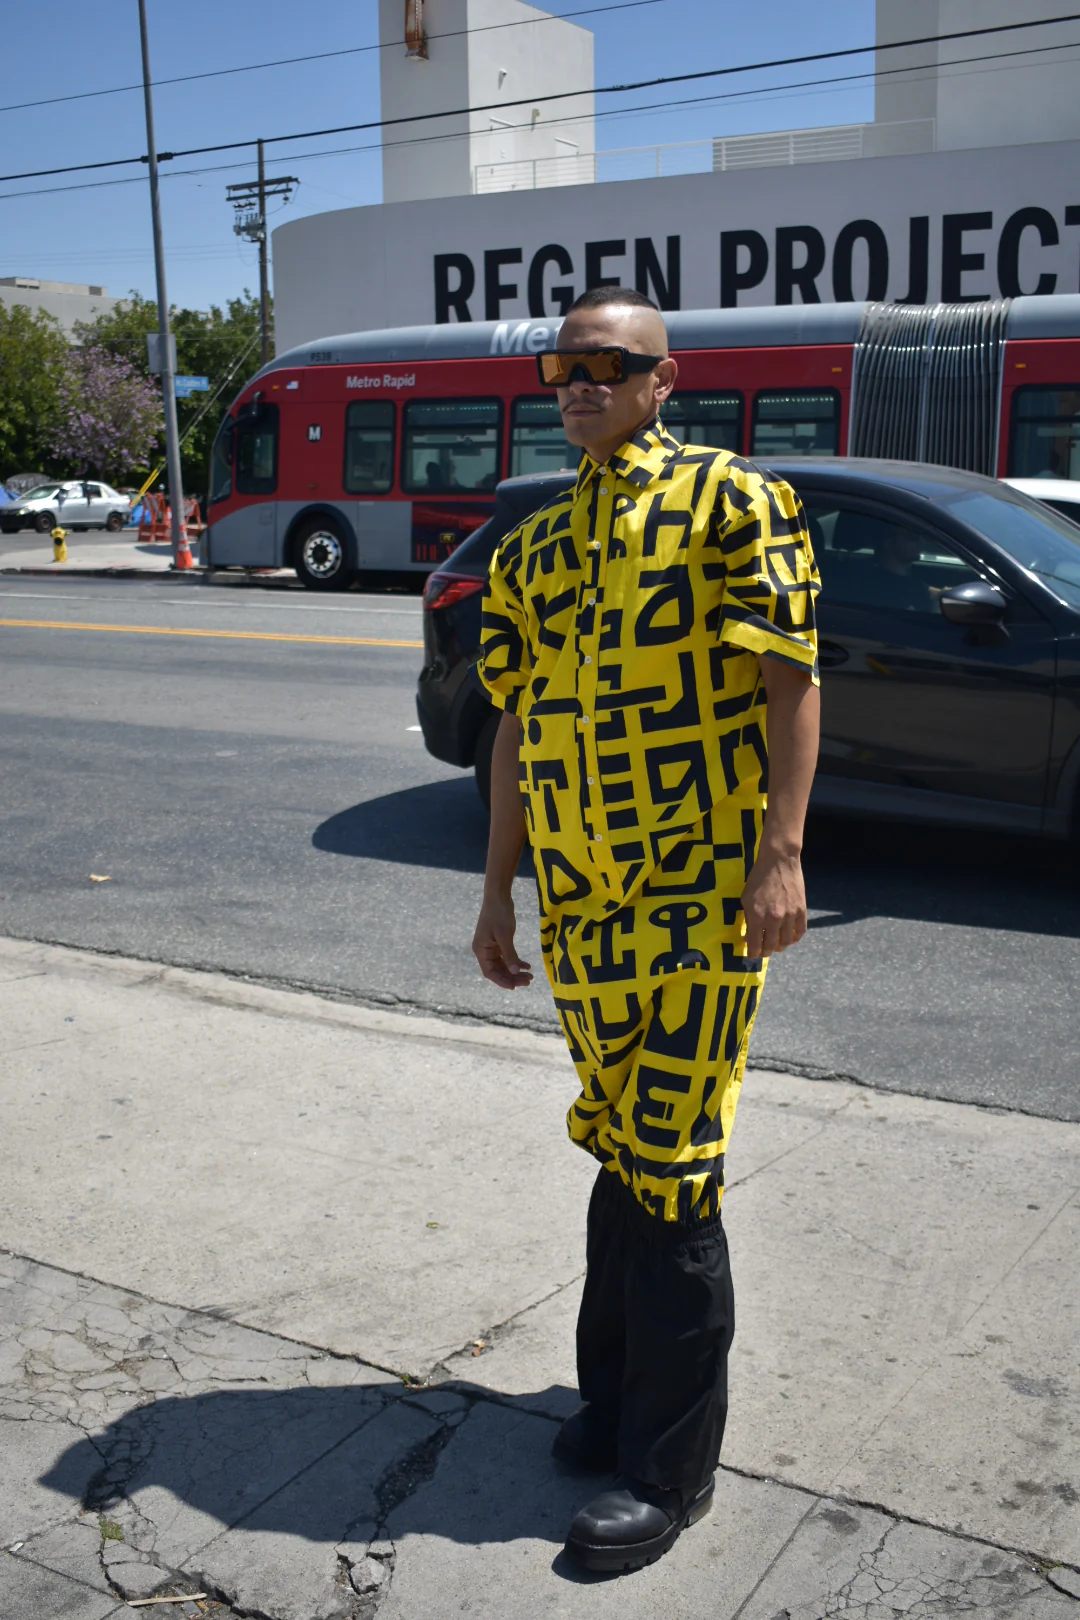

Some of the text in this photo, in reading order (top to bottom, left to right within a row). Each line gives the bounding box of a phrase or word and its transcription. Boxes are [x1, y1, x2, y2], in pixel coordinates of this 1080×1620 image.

[434, 235, 681, 324] REGEN
[346, 373, 416, 390] Metro Rapid
[308, 426, 321, 441] M
